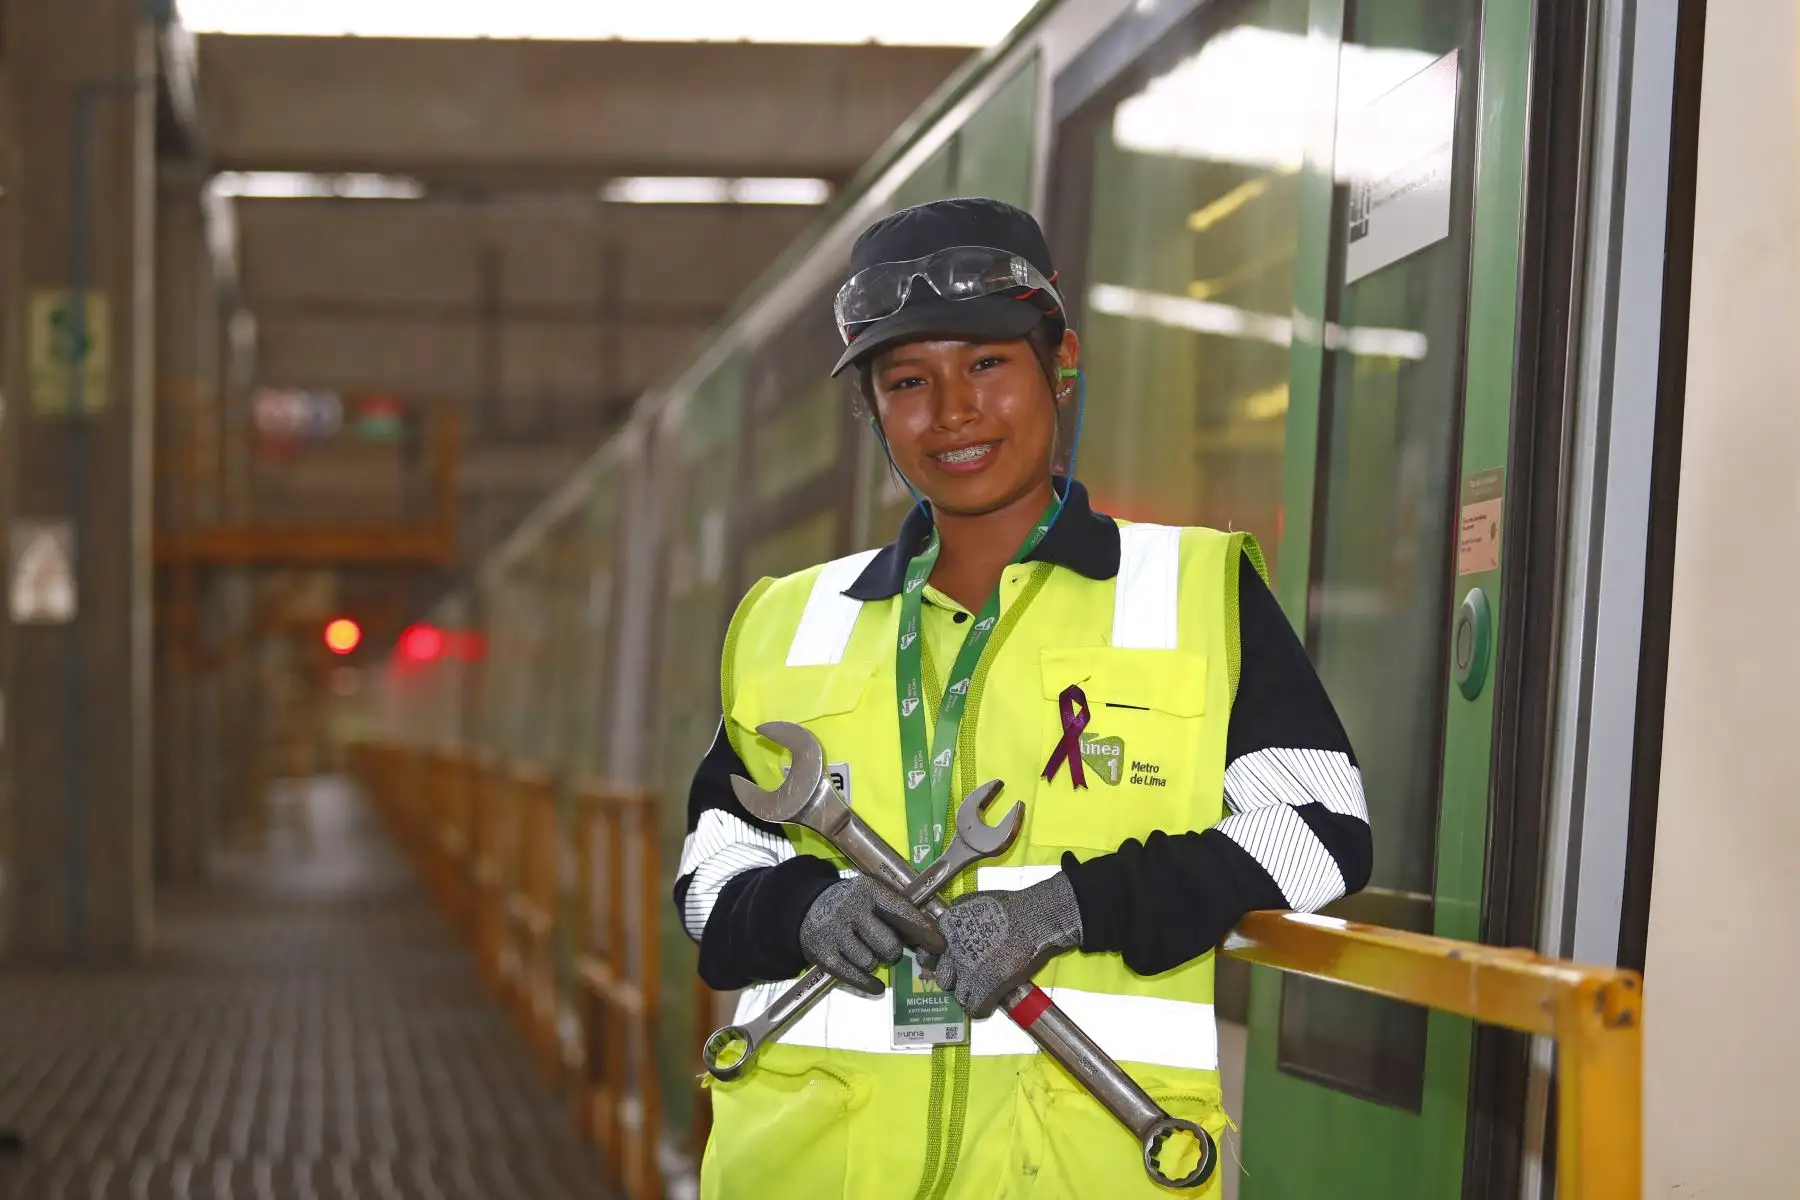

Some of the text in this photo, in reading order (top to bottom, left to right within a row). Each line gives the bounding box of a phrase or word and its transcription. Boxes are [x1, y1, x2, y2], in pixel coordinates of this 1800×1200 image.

[1107, 758, 1119, 781] 1
[1131, 761, 1160, 773] Metro
[1129, 774, 1167, 787] de Lima
[906, 996, 950, 1006] MICHELLE
